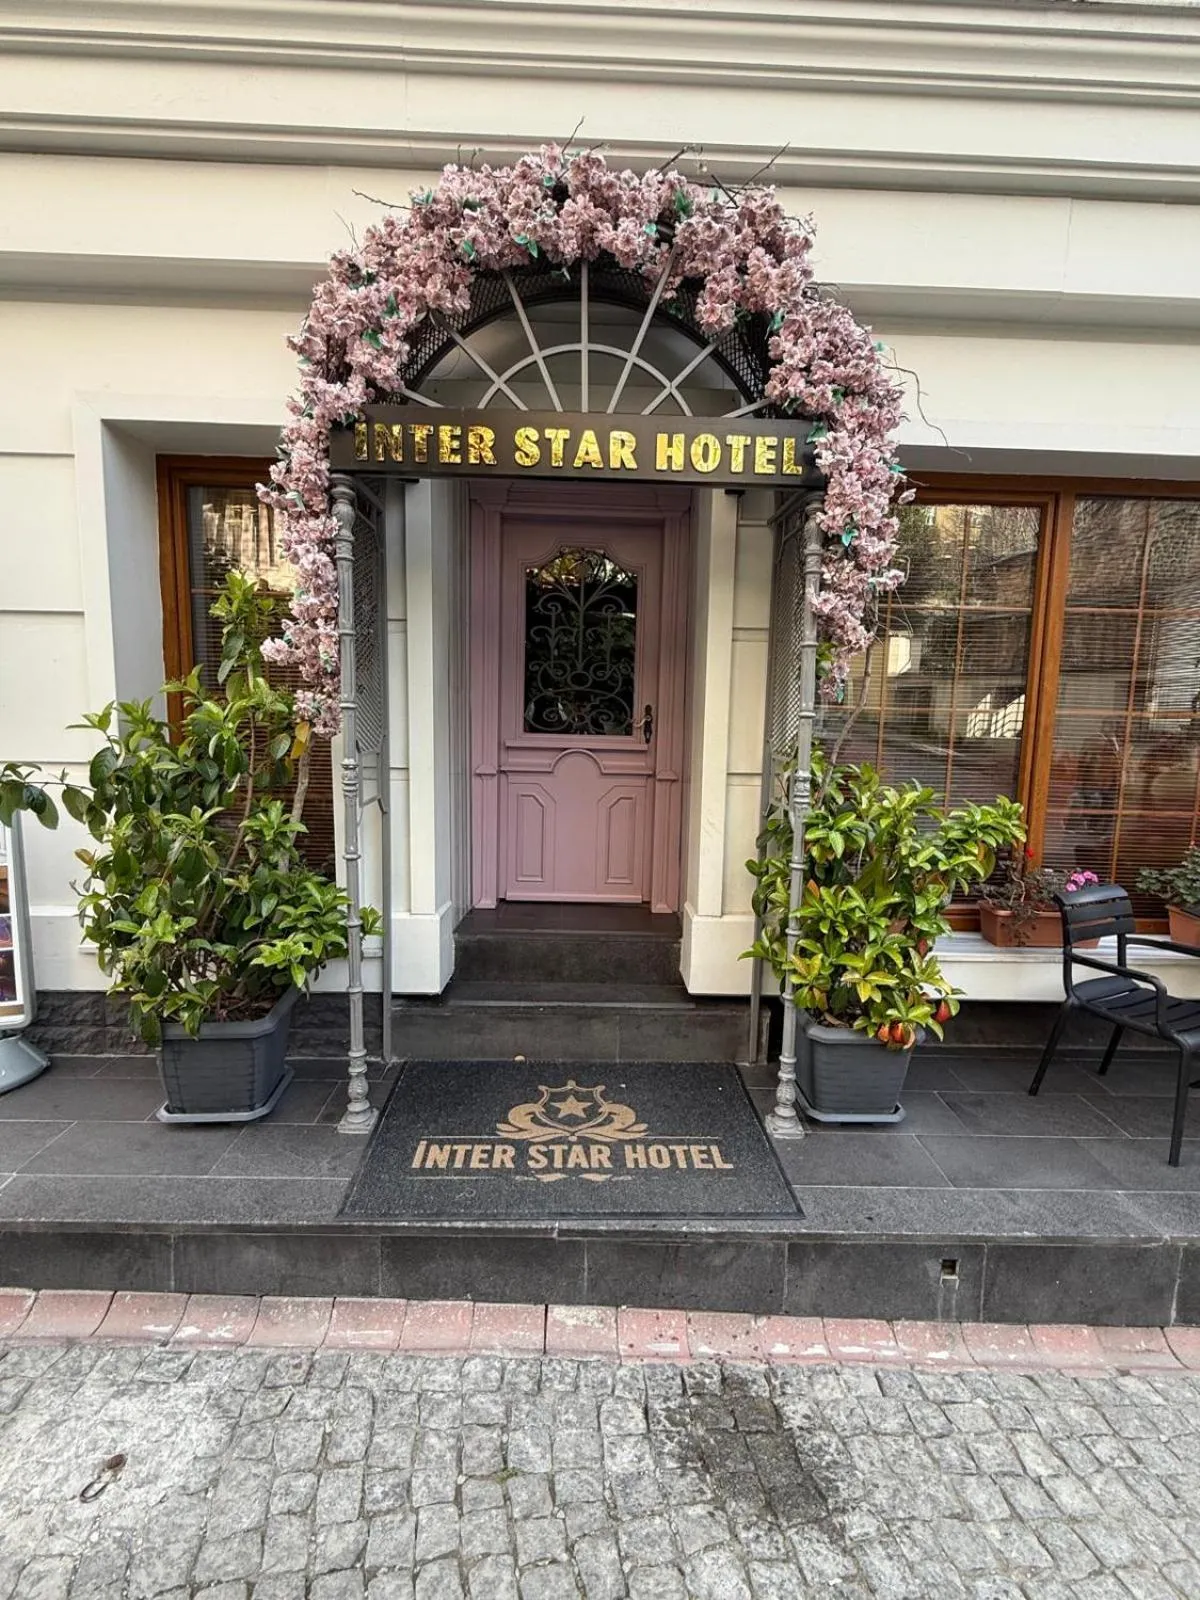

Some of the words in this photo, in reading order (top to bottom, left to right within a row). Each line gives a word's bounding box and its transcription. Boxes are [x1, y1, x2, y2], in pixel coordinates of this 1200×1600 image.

[353, 422, 497, 465] INTER
[514, 426, 638, 469] STAR
[655, 432, 802, 474] HOTEL
[411, 1140, 515, 1169] INTER
[527, 1143, 613, 1169] STAR
[625, 1144, 734, 1169] HOTEL
